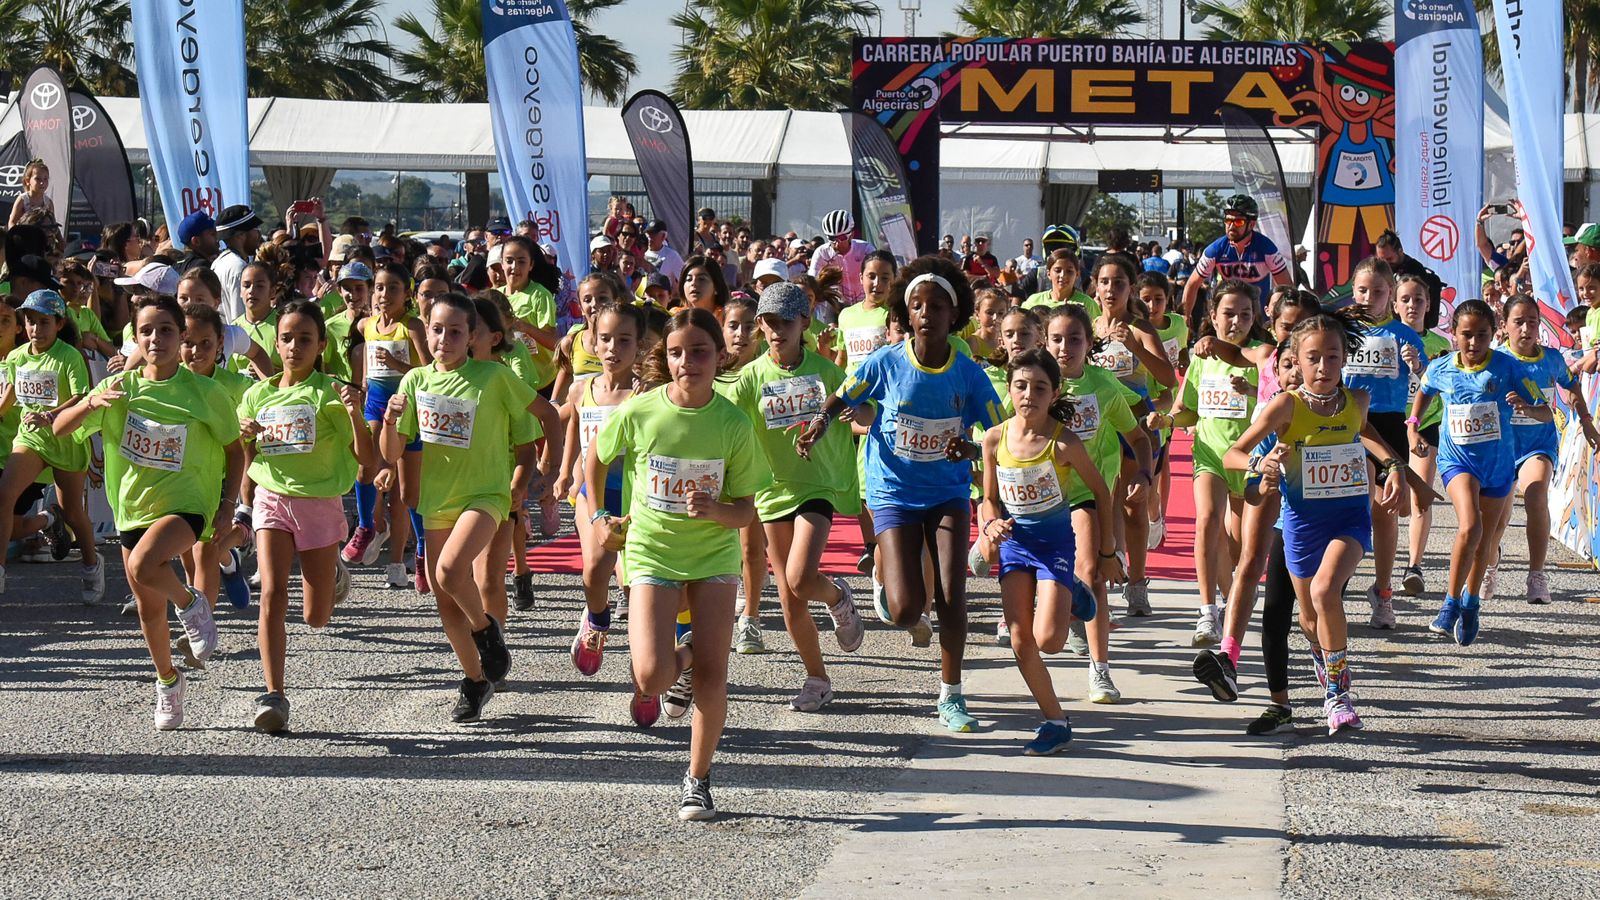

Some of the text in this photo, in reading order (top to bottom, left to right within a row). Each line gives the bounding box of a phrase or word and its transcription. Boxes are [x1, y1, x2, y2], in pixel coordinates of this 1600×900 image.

[862, 42, 1297, 66] CARRERA POPULAR PUERTO BAHÍA DE ALGECIRAS
[875, 89, 919, 98] Puerto de
[960, 68, 1298, 116] META
[862, 99, 920, 112] Algeciras
[1151, 174, 1159, 188] 3
[1220, 263, 1260, 278] UCA
[849, 339, 872, 352] 1080
[18, 380, 42, 396] 1338
[767, 393, 804, 416] 1317
[1201, 390, 1229, 406] 1352
[1451, 418, 1481, 433] 1163
[127, 429, 161, 456] 1331
[901, 430, 939, 450] 1486
[1308, 464, 1350, 484] 1073
[1002, 483, 1038, 501] 1158
